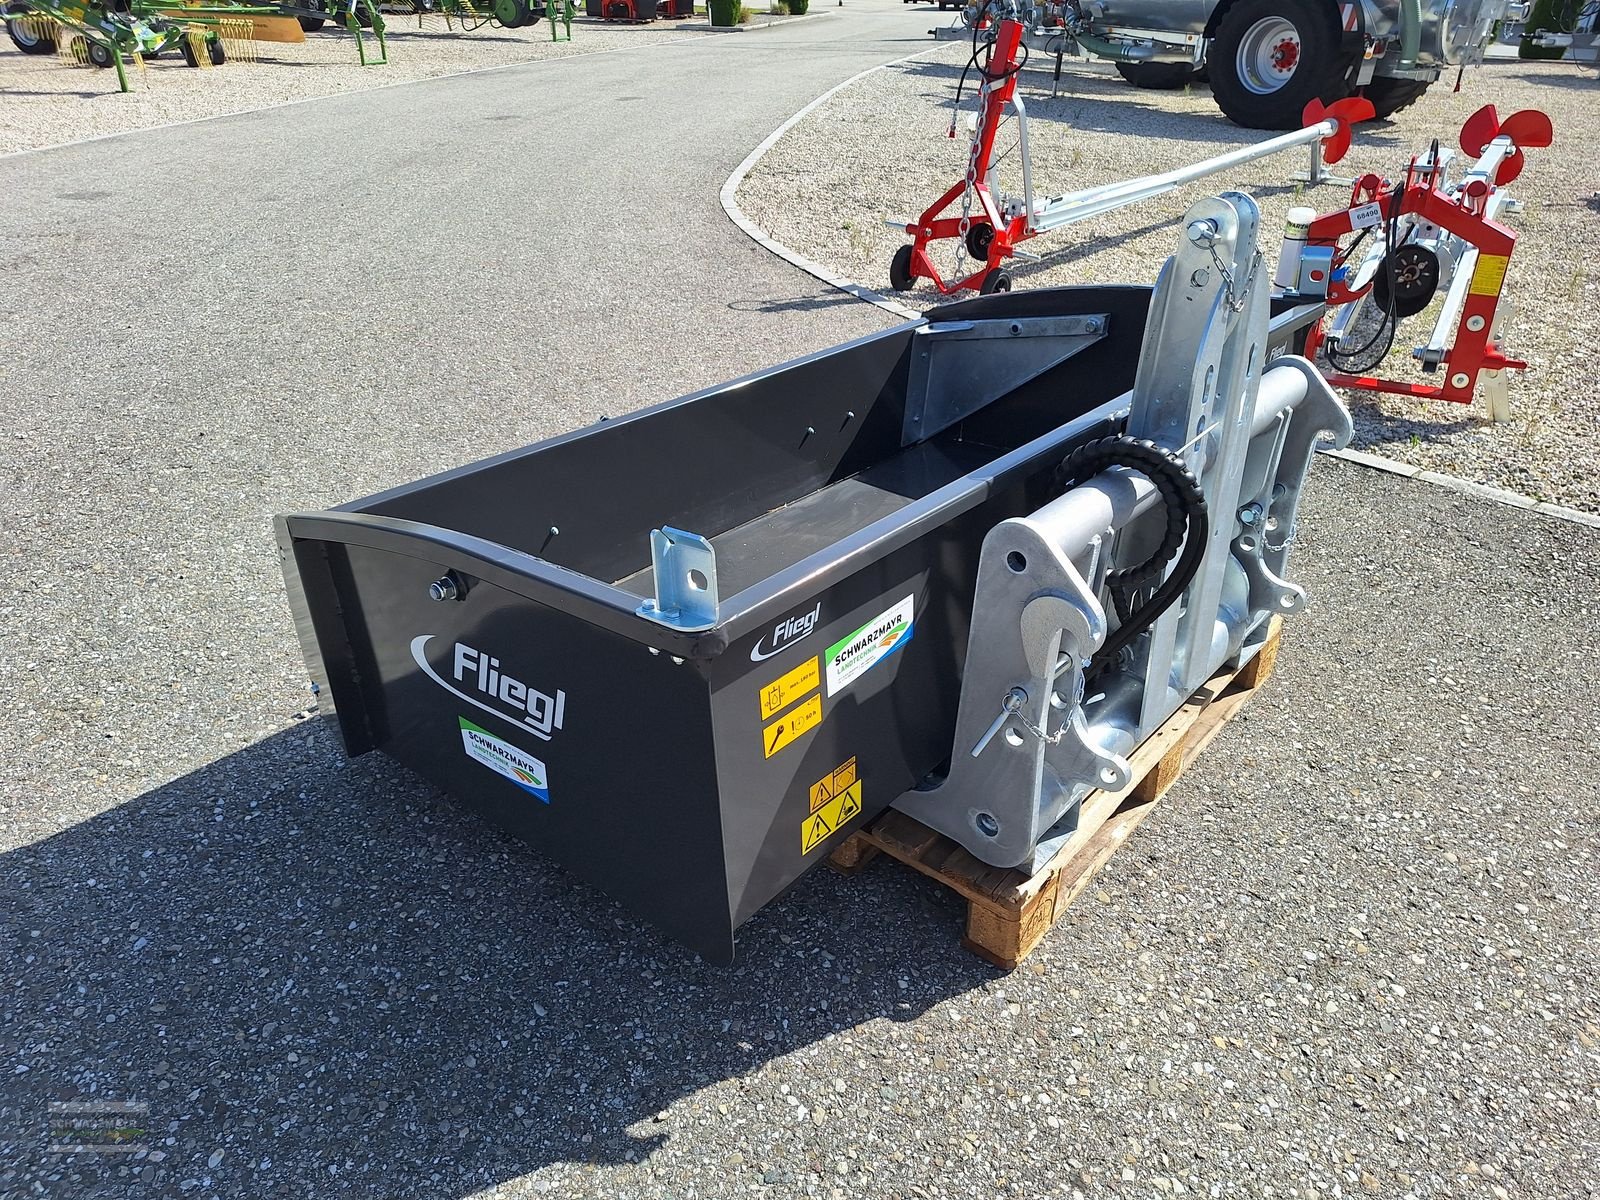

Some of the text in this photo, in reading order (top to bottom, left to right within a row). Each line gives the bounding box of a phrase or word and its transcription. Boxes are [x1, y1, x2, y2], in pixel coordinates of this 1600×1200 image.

[1356, 209, 1379, 220] 68490
[772, 602, 822, 647] Fliegl
[835, 614, 902, 667] SCHWARZMAYR
[837, 644, 877, 675] LANDTECHNIK
[453, 642, 566, 734] Fliegl
[468, 730, 535, 775] SCHWARZMAYR
[472, 742, 510, 768] LANDTECHNIK
